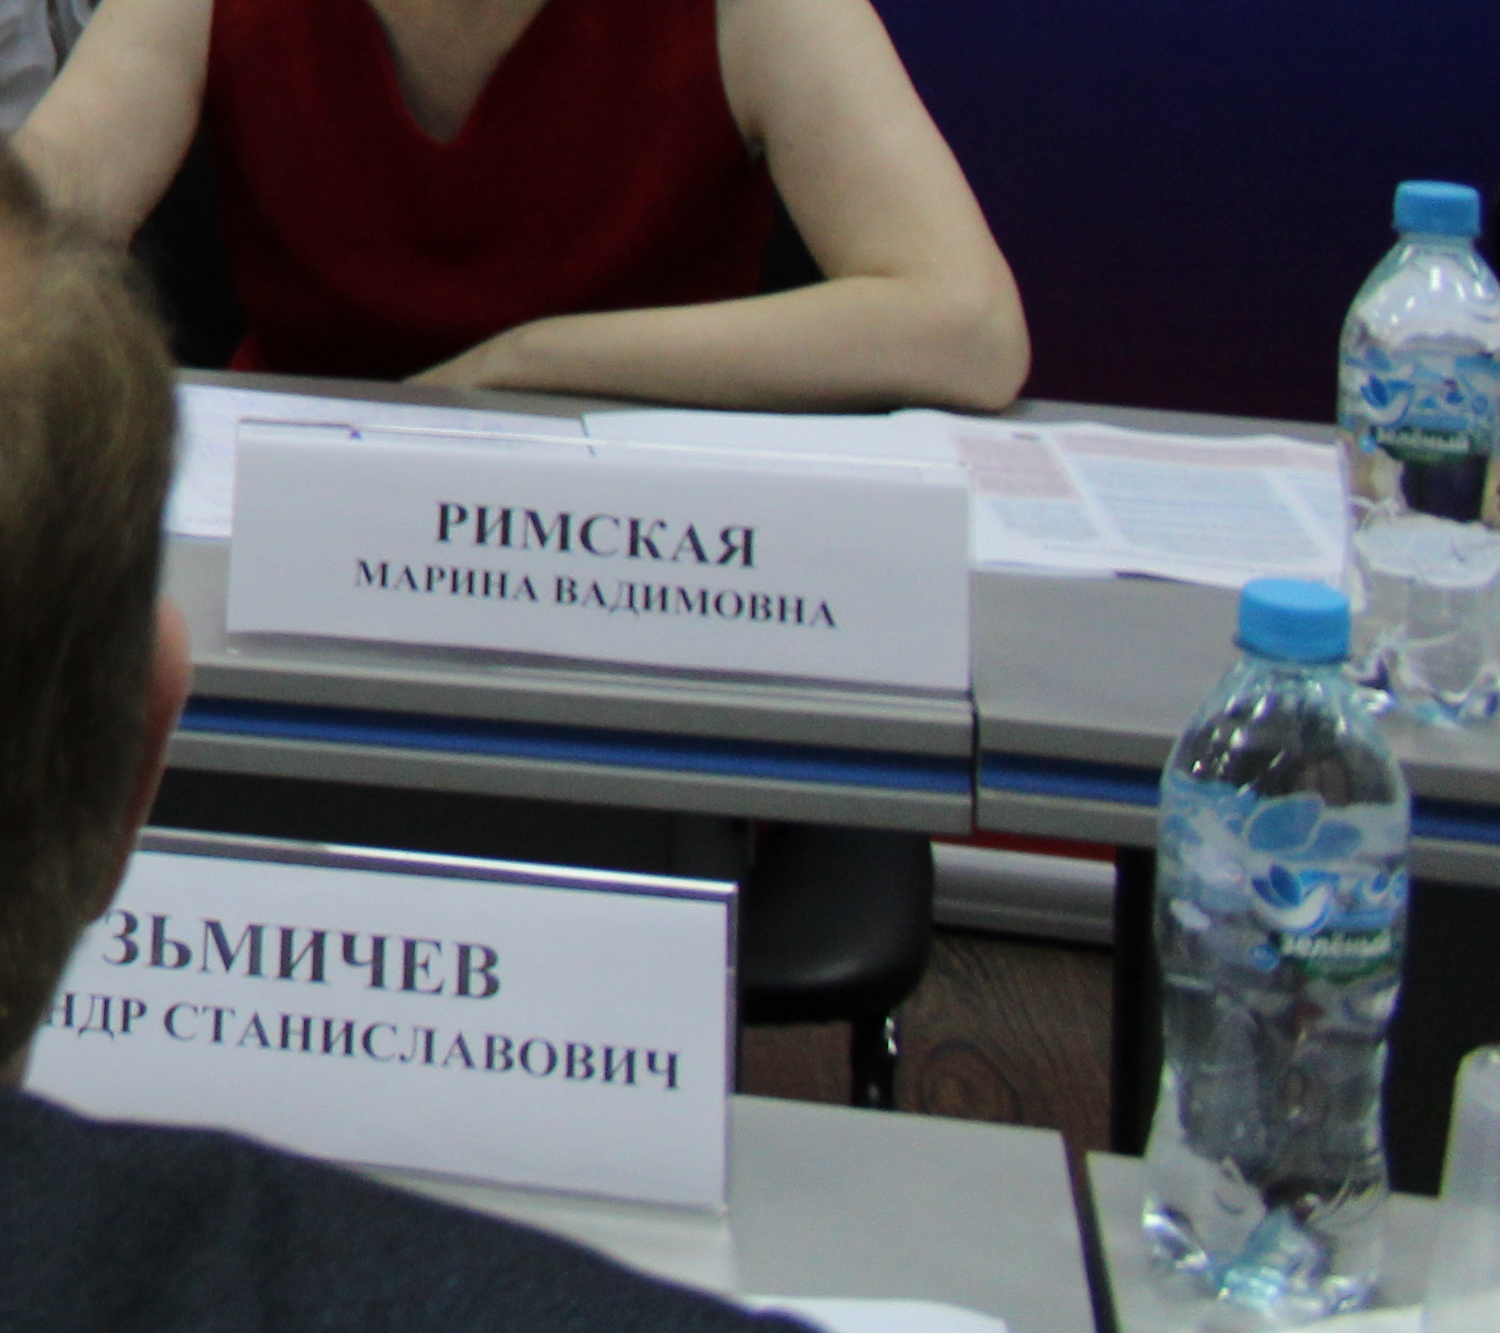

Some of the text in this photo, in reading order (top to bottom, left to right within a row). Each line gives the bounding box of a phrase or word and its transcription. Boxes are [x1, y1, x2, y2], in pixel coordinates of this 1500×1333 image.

[436, 500, 760, 569] РИМСКАЯ
[354, 558, 838, 631] МАРИНА ВАДИМОВНА
[102, 908, 502, 1001] ЗЬМИЧЕВ
[164, 1000, 683, 1093] СТАНИСЛАВОВИЧ
